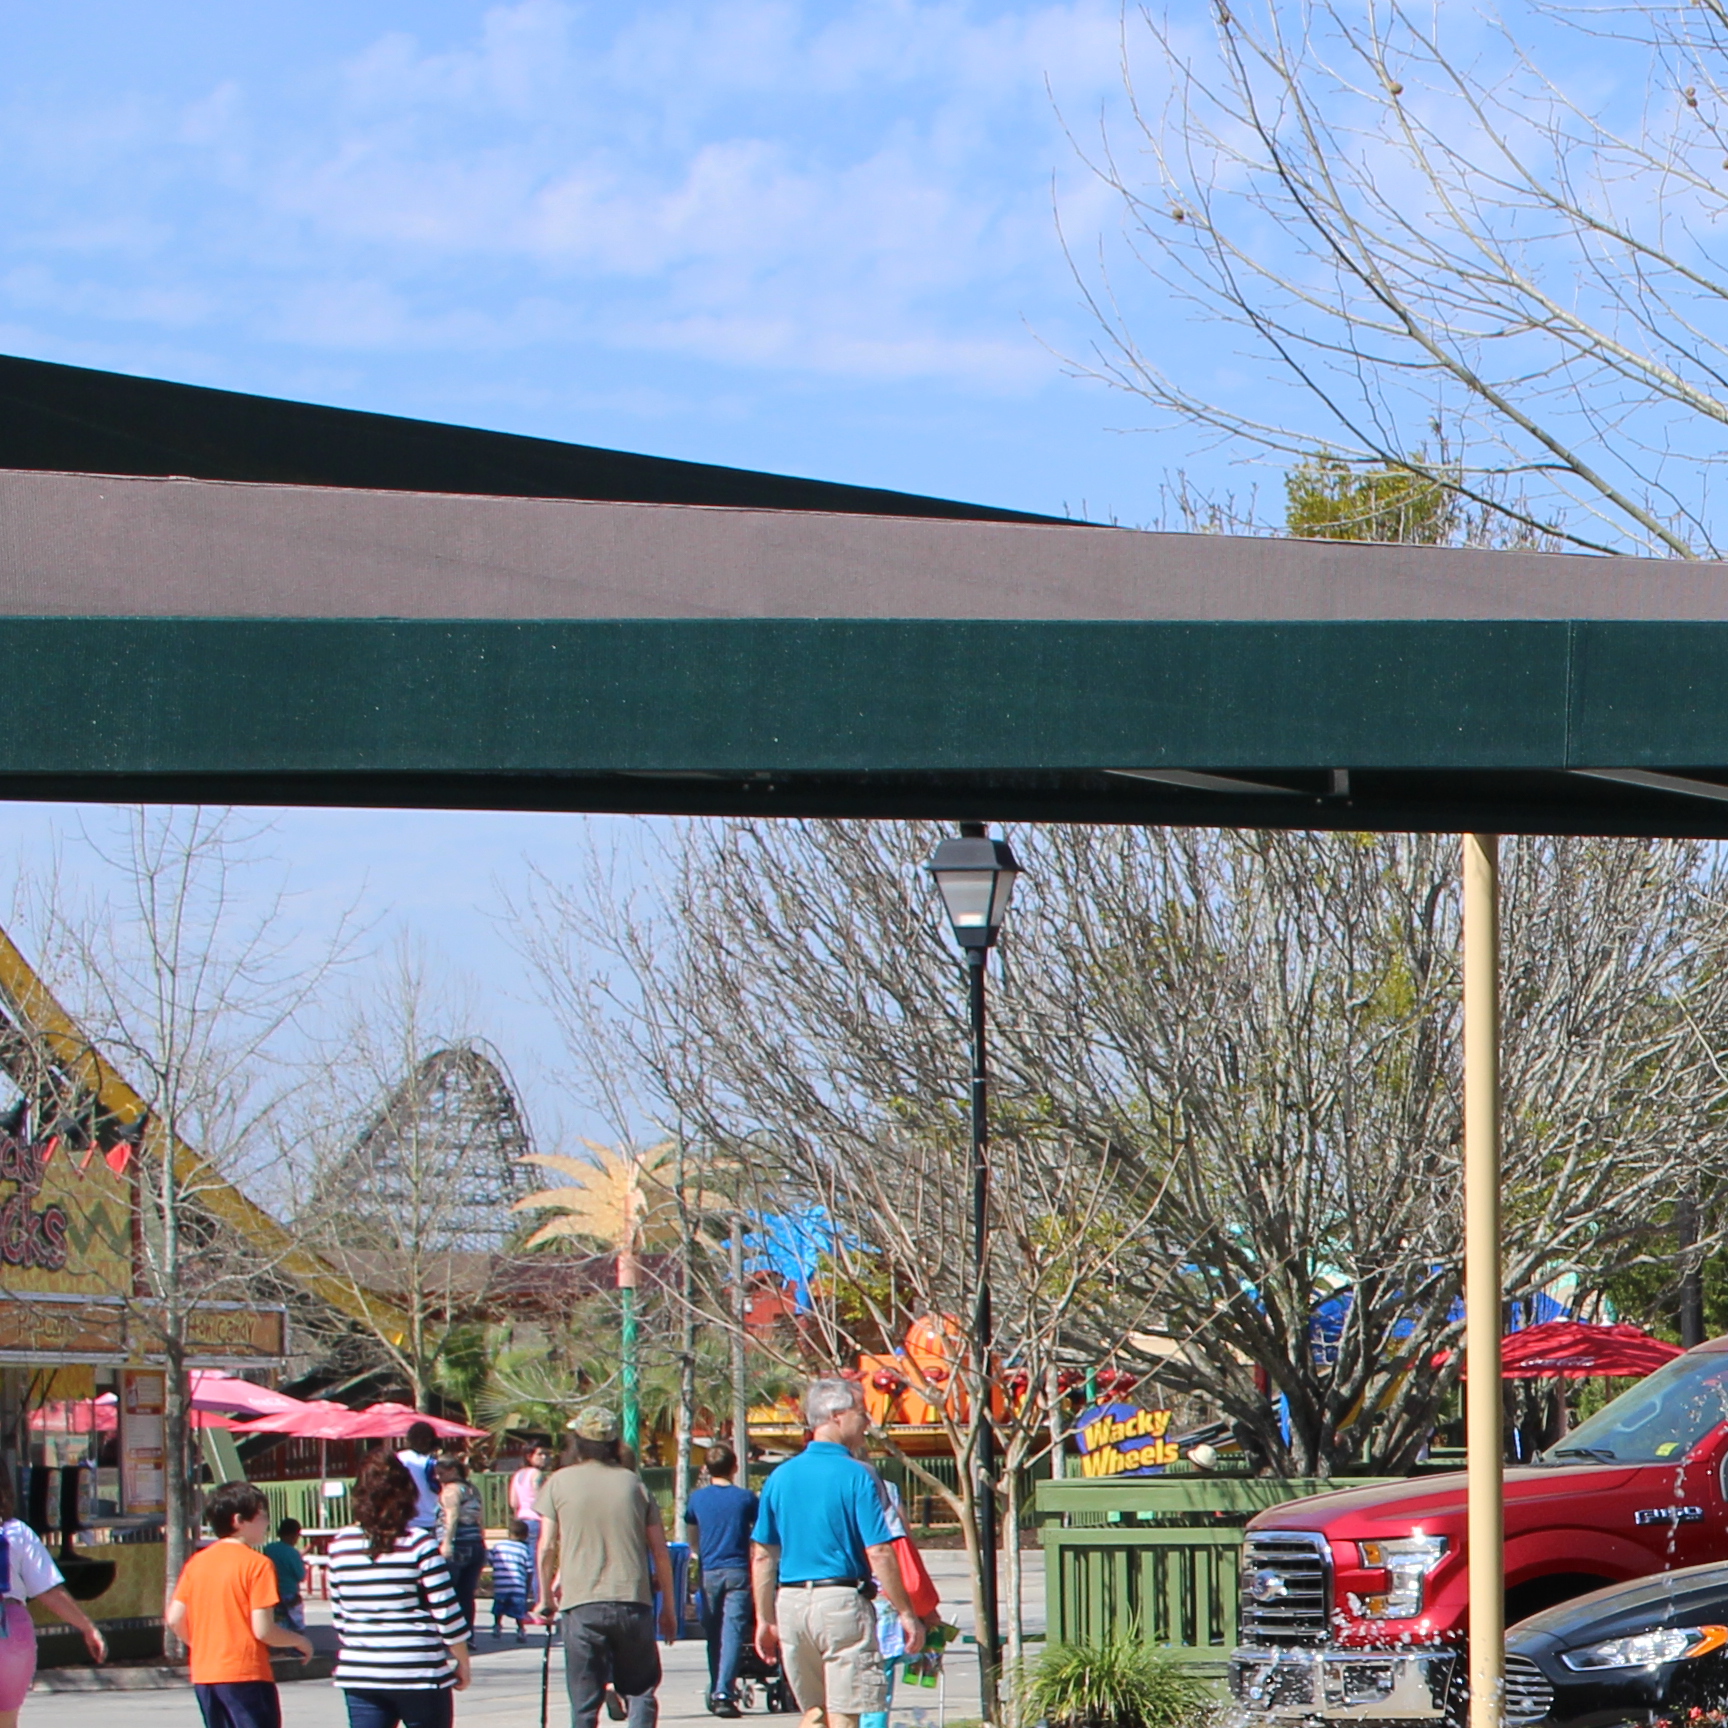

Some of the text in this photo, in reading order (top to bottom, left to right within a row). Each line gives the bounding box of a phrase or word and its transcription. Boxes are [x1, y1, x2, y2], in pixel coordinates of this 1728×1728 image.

[0, 1192, 67, 1269] cks
[1084, 1408, 1172, 1451] Wacky
[1082, 1437, 1179, 1477] Wheels
